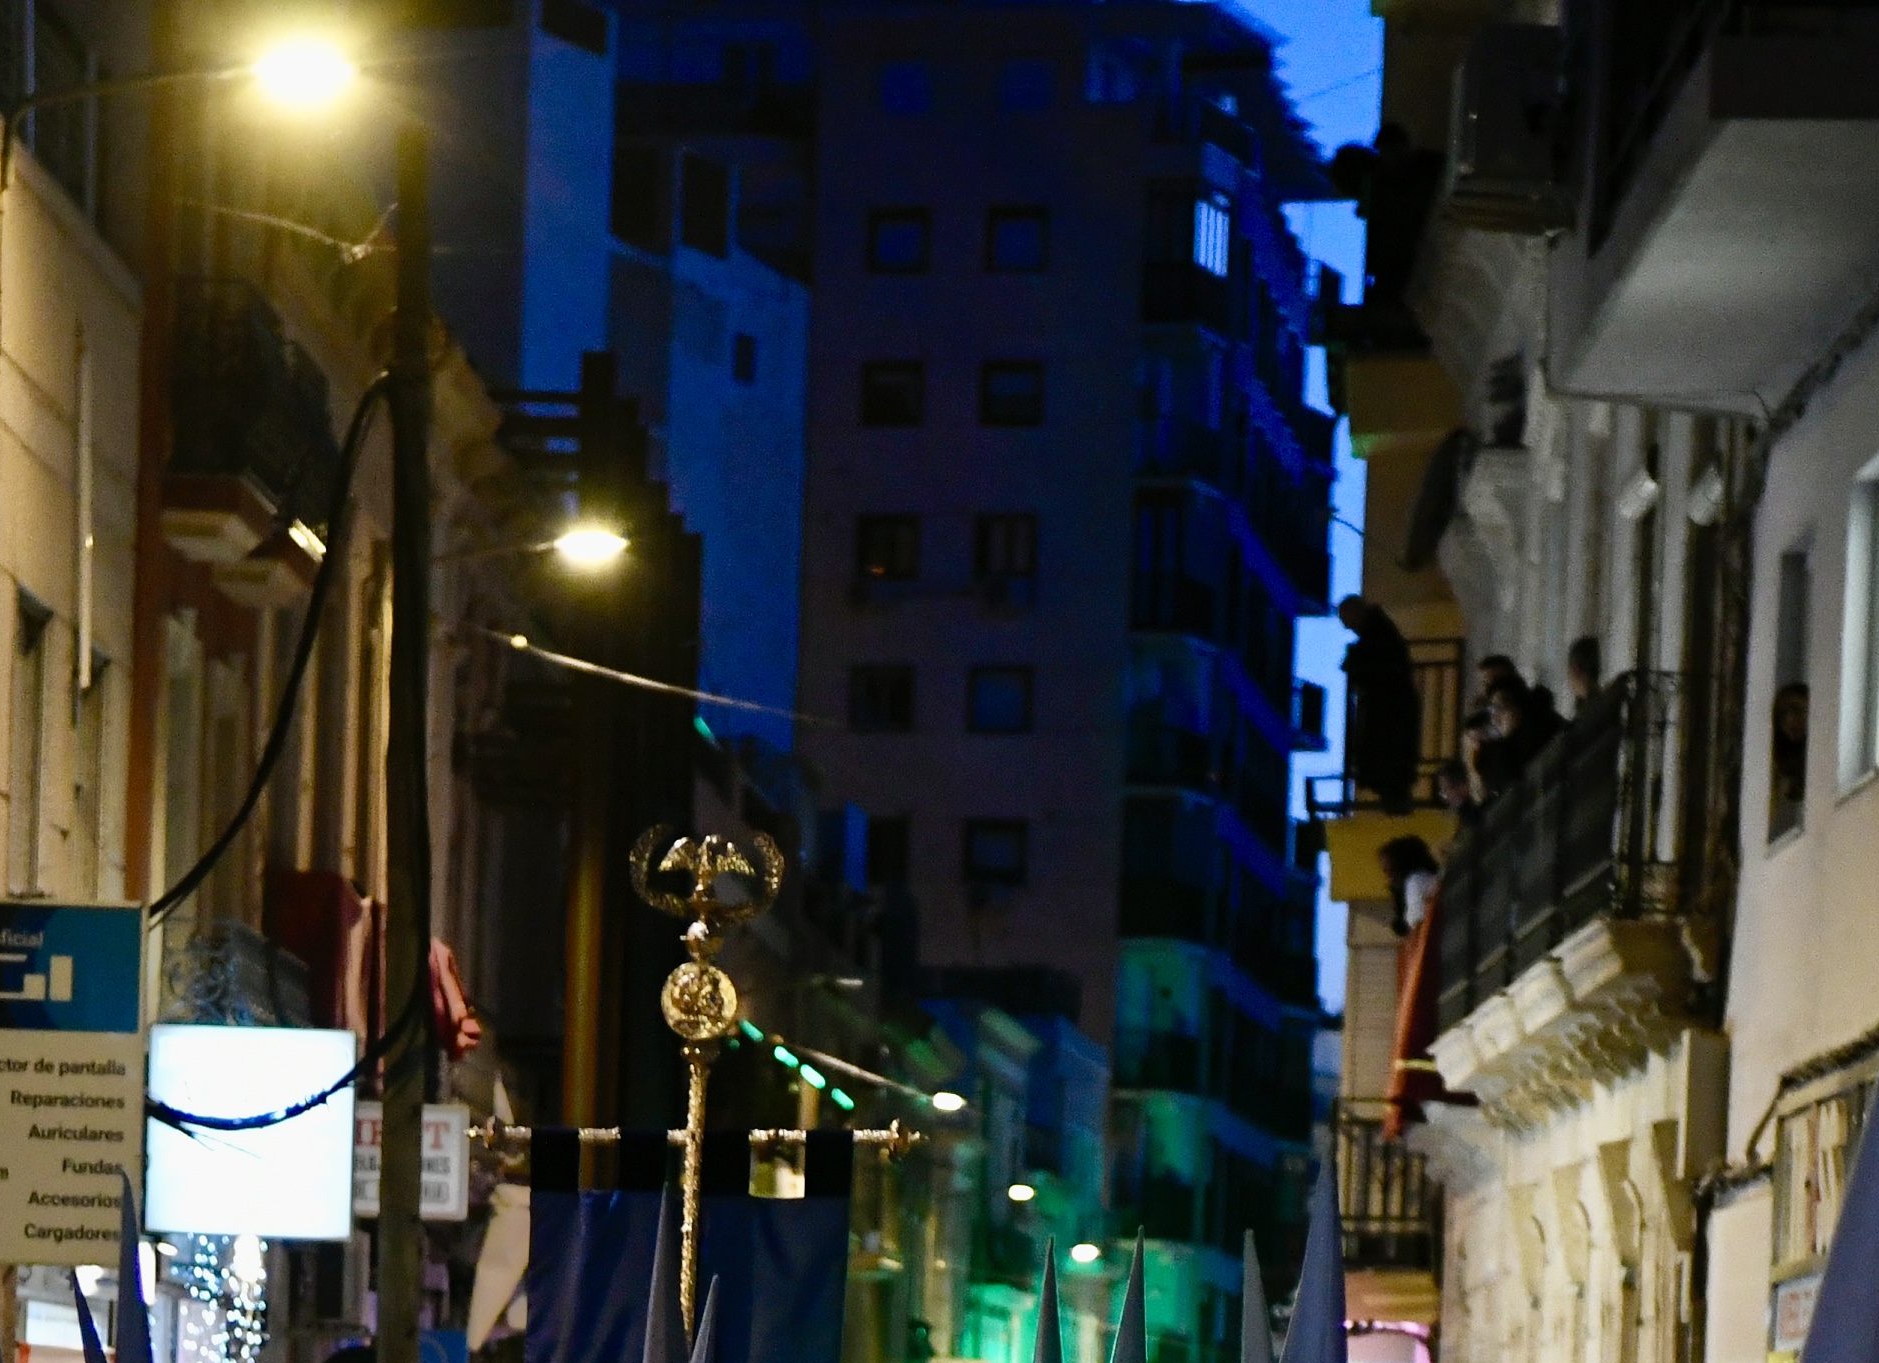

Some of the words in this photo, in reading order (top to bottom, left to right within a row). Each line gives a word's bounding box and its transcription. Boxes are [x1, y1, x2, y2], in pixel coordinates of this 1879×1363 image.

[34, 1058, 55, 1075] de
[59, 1059, 126, 1077] pantalla
[11, 1090, 125, 1109] Reparaciones
[28, 1124, 124, 1143] Auriculares
[62, 1158, 122, 1175] Fundas
[28, 1191, 122, 1208] Accesorios
[24, 1223, 121, 1243] Cargadores
